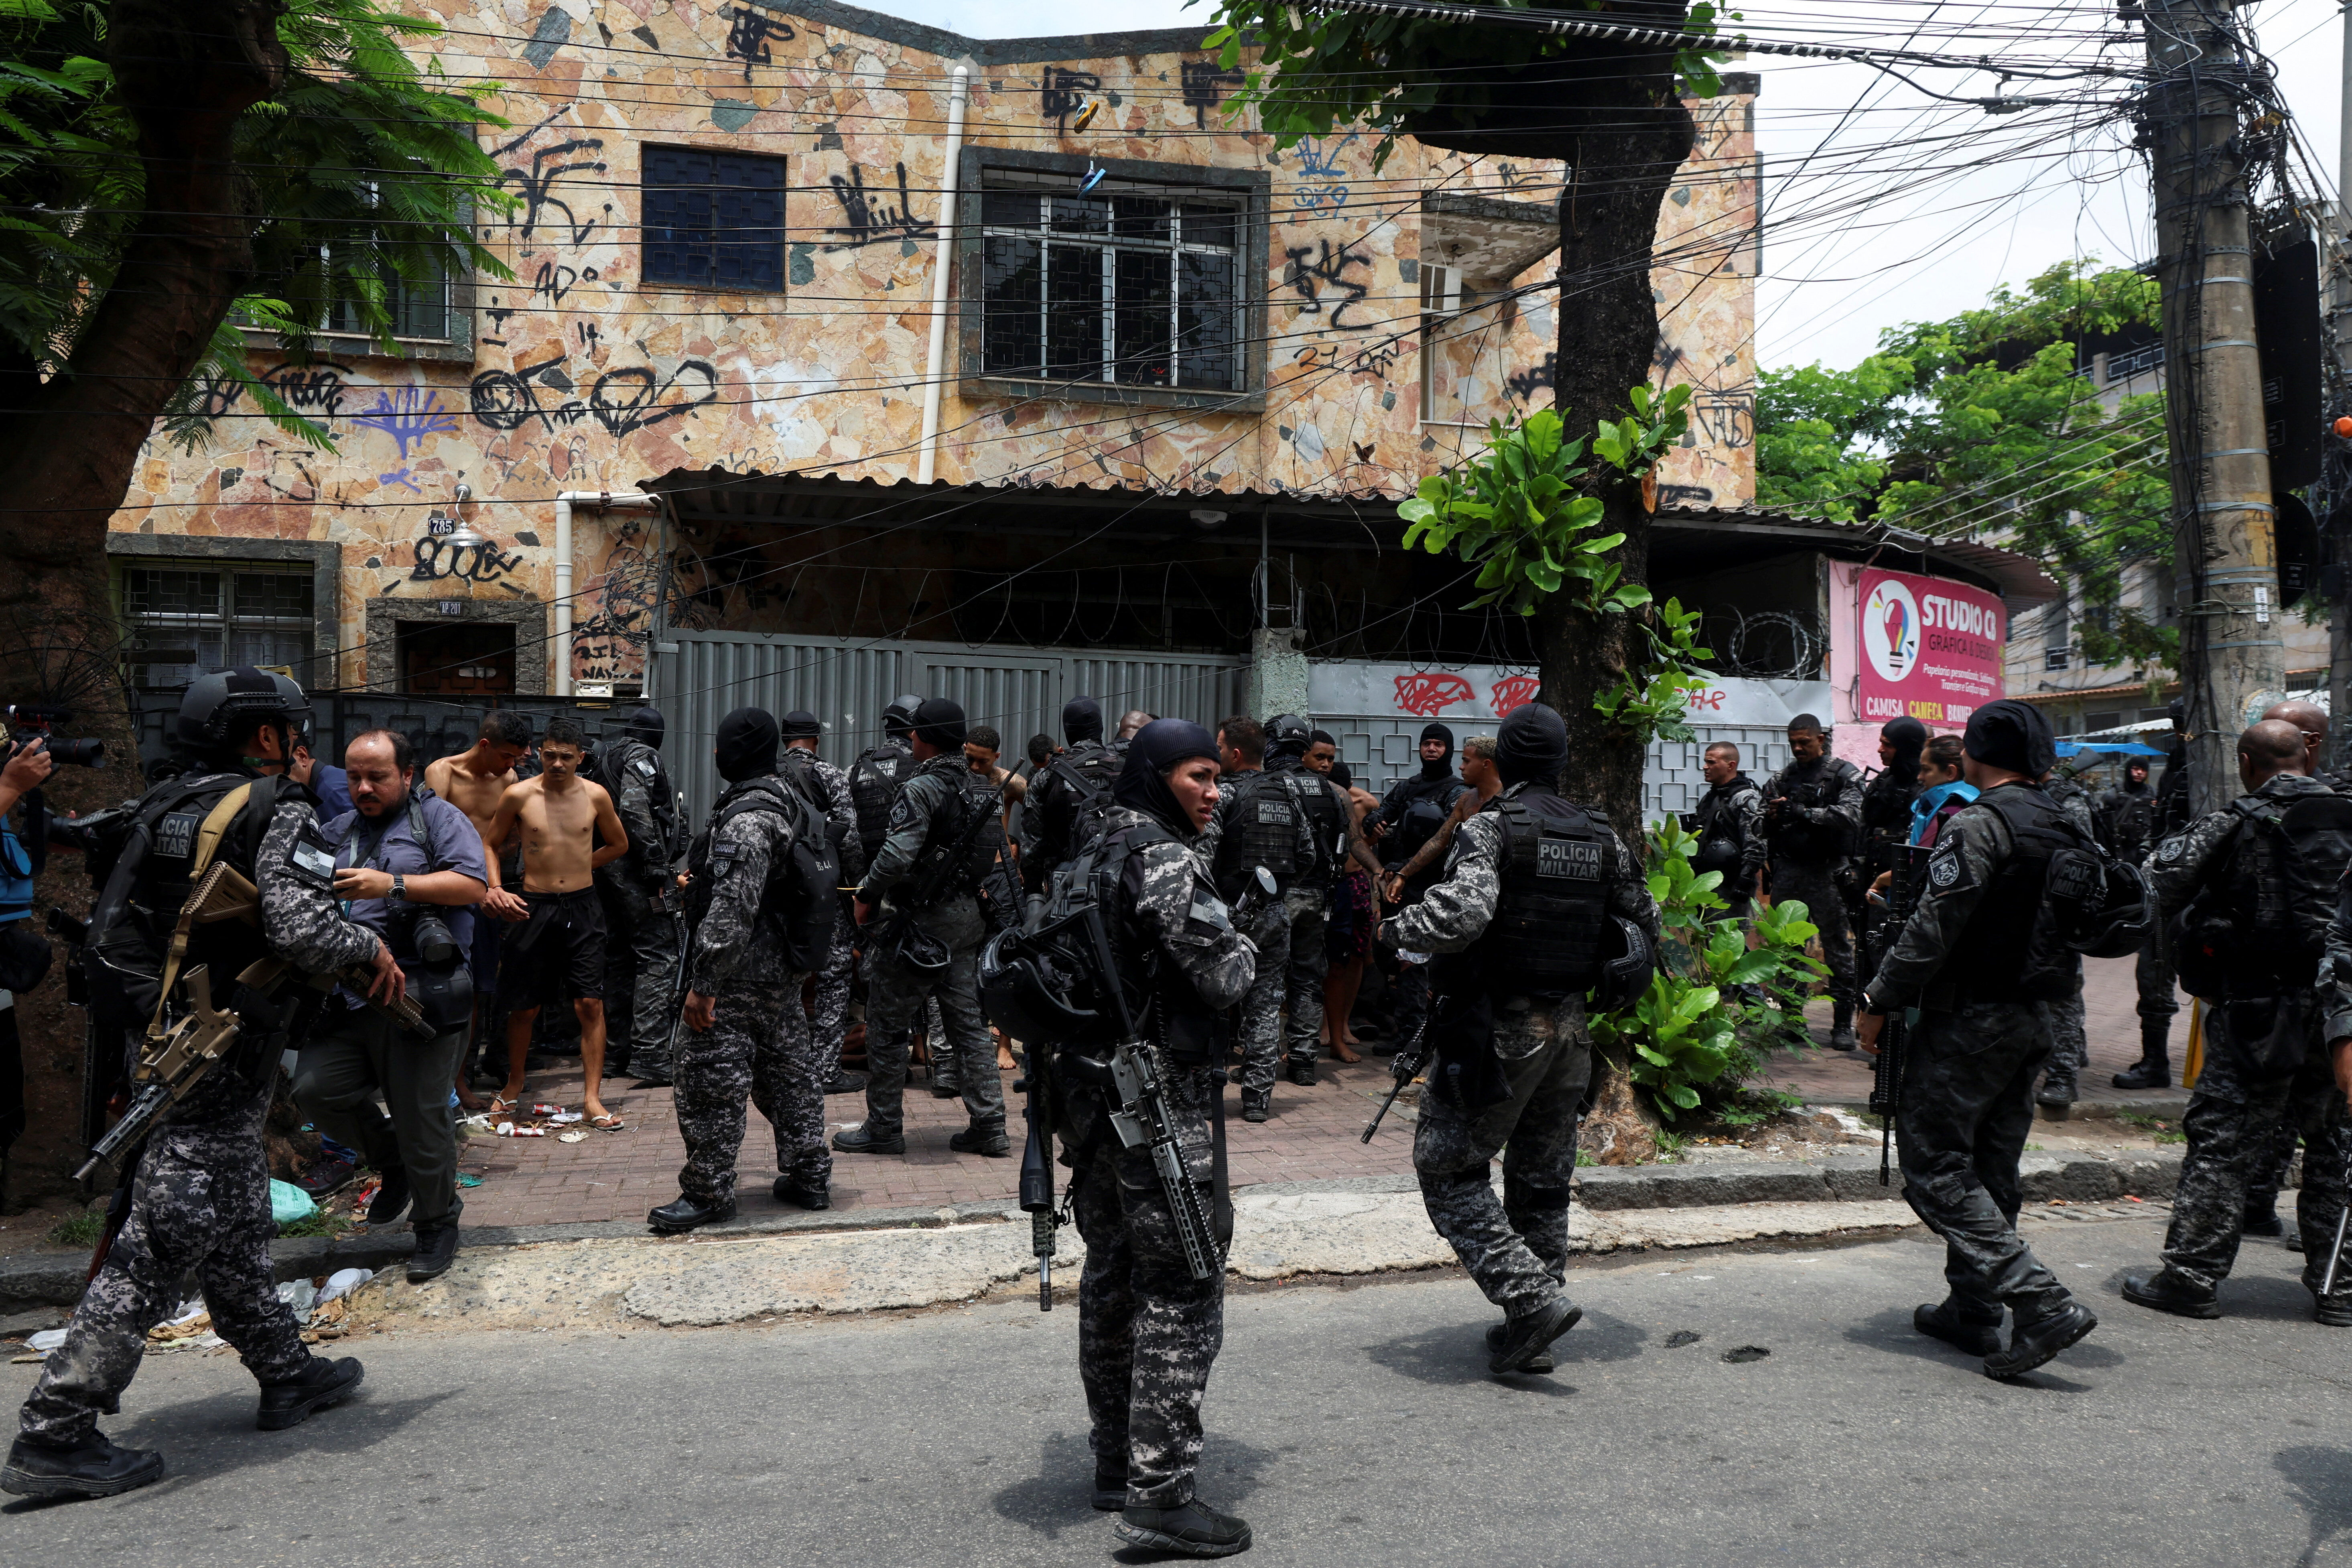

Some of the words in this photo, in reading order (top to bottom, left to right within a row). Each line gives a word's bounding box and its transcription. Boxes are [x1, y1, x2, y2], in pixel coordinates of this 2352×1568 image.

[432, 520, 452, 534] 785
[451, 603, 461, 614] 201
[1922, 594, 1982, 636] STUDIO
[1984, 609, 1997, 641] CB
[1929, 631, 1968, 655] GRÁFICA
[1923, 663, 1950, 677] Papelaria
[1867, 697, 1904, 717] CAMISA
[1909, 700, 1944, 721] CANECA
[1286, 778, 1318, 786] POÍCIA
[1259, 803, 1290, 814] POLÍCIA
[1259, 813, 1290, 824] MILITAR
[715, 843, 736, 853] CHOQUE
[1540, 844, 1599, 863] POLÍCIA
[823, 860, 832, 869] 44
[1538, 860, 1598, 879] MILITAR
